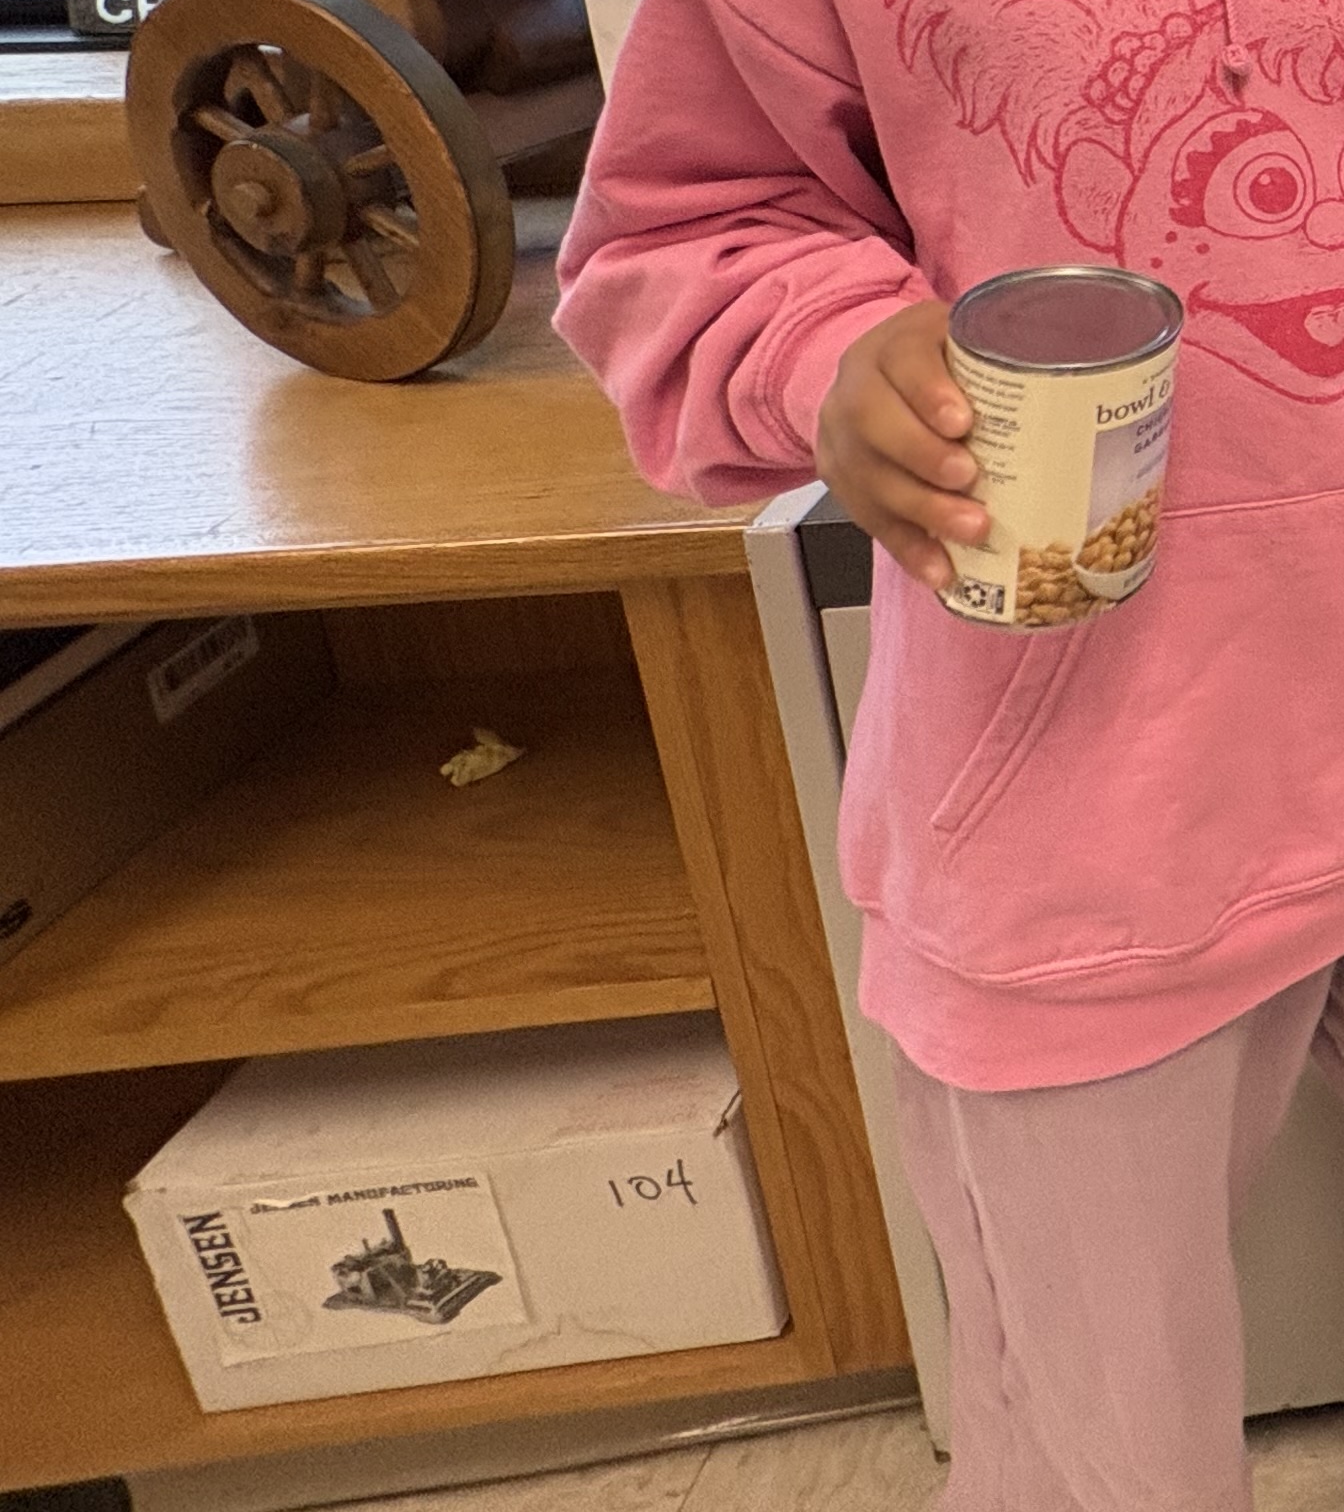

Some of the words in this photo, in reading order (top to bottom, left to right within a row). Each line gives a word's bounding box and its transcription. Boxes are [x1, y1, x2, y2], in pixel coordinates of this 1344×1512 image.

[1096, 385, 1155, 425] bowl
[608, 1159, 699, 1207] 104
[181, 1208, 263, 1324] JENSEN
